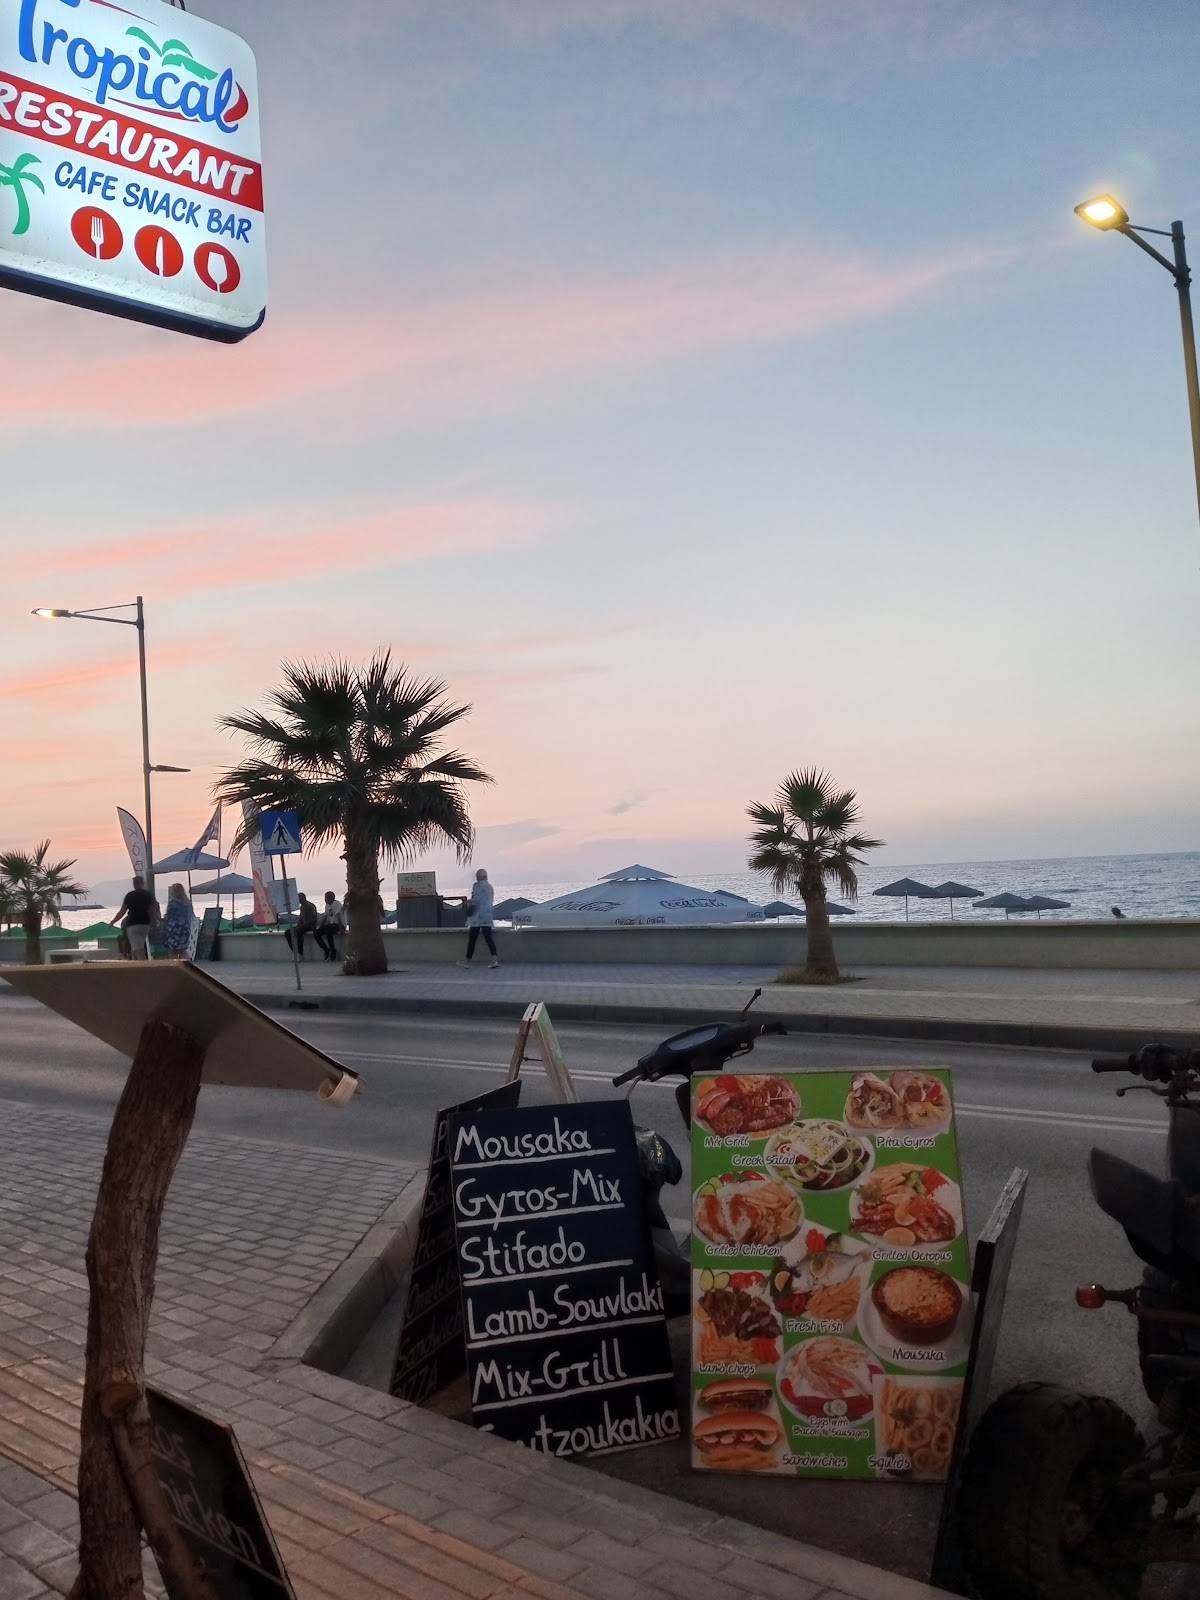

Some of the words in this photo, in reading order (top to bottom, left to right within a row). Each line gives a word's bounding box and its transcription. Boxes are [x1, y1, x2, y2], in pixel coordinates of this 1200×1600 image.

[18, 0, 239, 133] Tropical
[0, 80, 254, 196] RESTAURANT
[54, 161, 118, 201] CAFE
[123, 183, 201, 228] SNACK
[206, 208, 252, 243] BAR
[454, 1117, 592, 1162] Mousaka
[723, 1135, 750, 1148] Grill
[876, 1137, 899, 1148] Pita
[903, 1136, 935, 1149] Gyros
[732, 1154, 763, 1167] Greek
[766, 1153, 796, 1166] Salad
[456, 1169, 621, 1230] Gyros-Mix
[460, 1226, 586, 1279] Stifado
[705, 1243, 741, 1256] Grilled
[742, 1243, 781, 1257] Chicken
[872, 1249, 910, 1262] Grilled
[911, 1249, 952, 1263] Octopus
[466, 1272, 664, 1341] Lamb-Souvlaki
[786, 1320, 818, 1333] Fresh
[820, 1320, 843, 1334] Fish
[892, 1349, 946, 1362] Mousaka
[472, 1338, 627, 1402] Mix-Grill
[782, 1453, 848, 1468] Sandwiches
[867, 1454, 912, 1471] Squids
